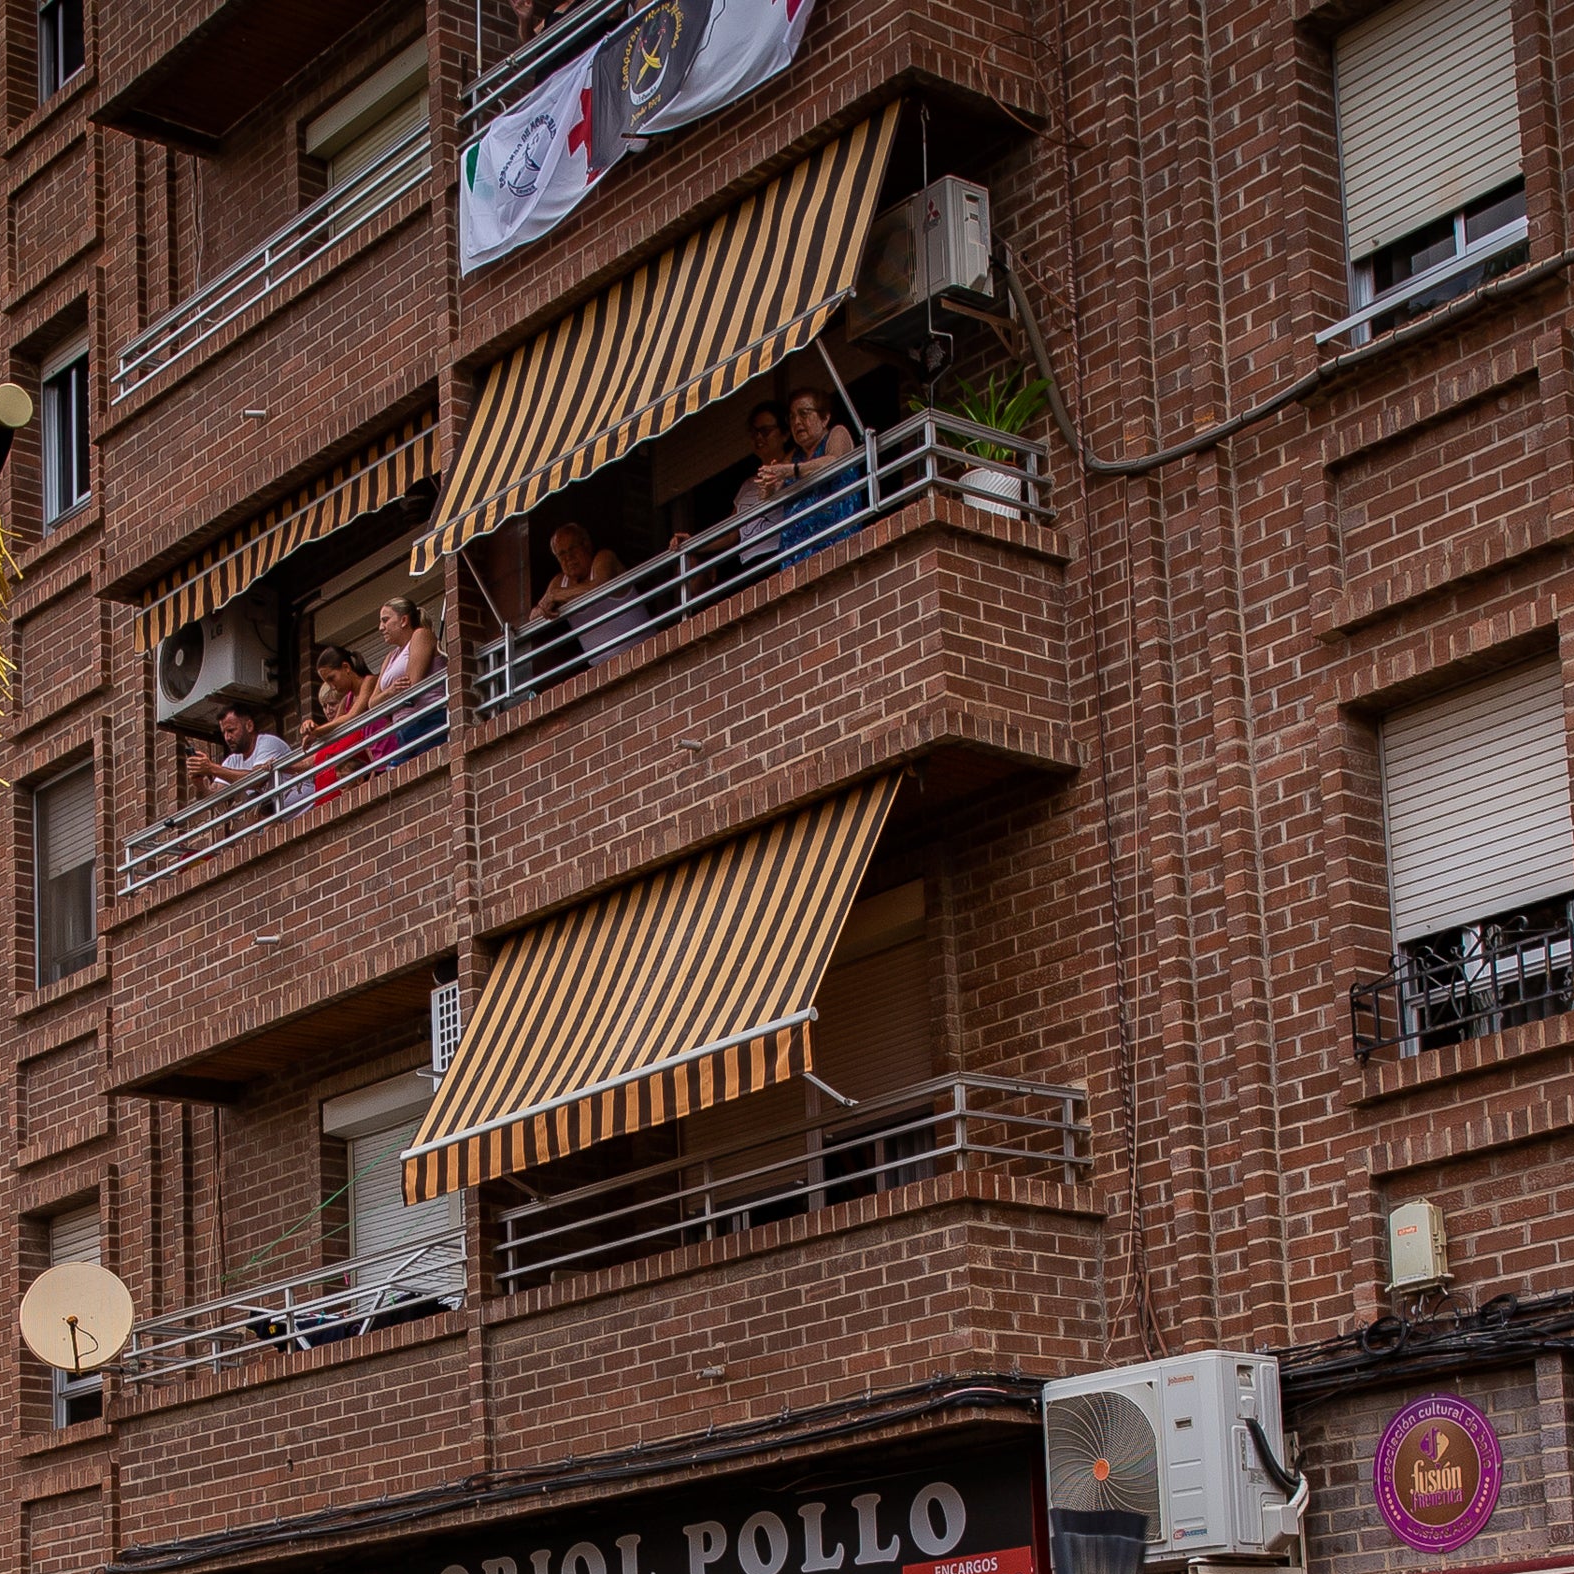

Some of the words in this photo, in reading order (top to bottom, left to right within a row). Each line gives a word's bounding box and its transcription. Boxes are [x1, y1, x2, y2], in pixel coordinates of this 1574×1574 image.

[1384, 1414, 1416, 1482] asociación
[1418, 1402, 1465, 1420] cultural
[1465, 1416, 1478, 1433] de
[1477, 1430, 1492, 1469] baile
[1410, 1460, 1462, 1494] fusión
